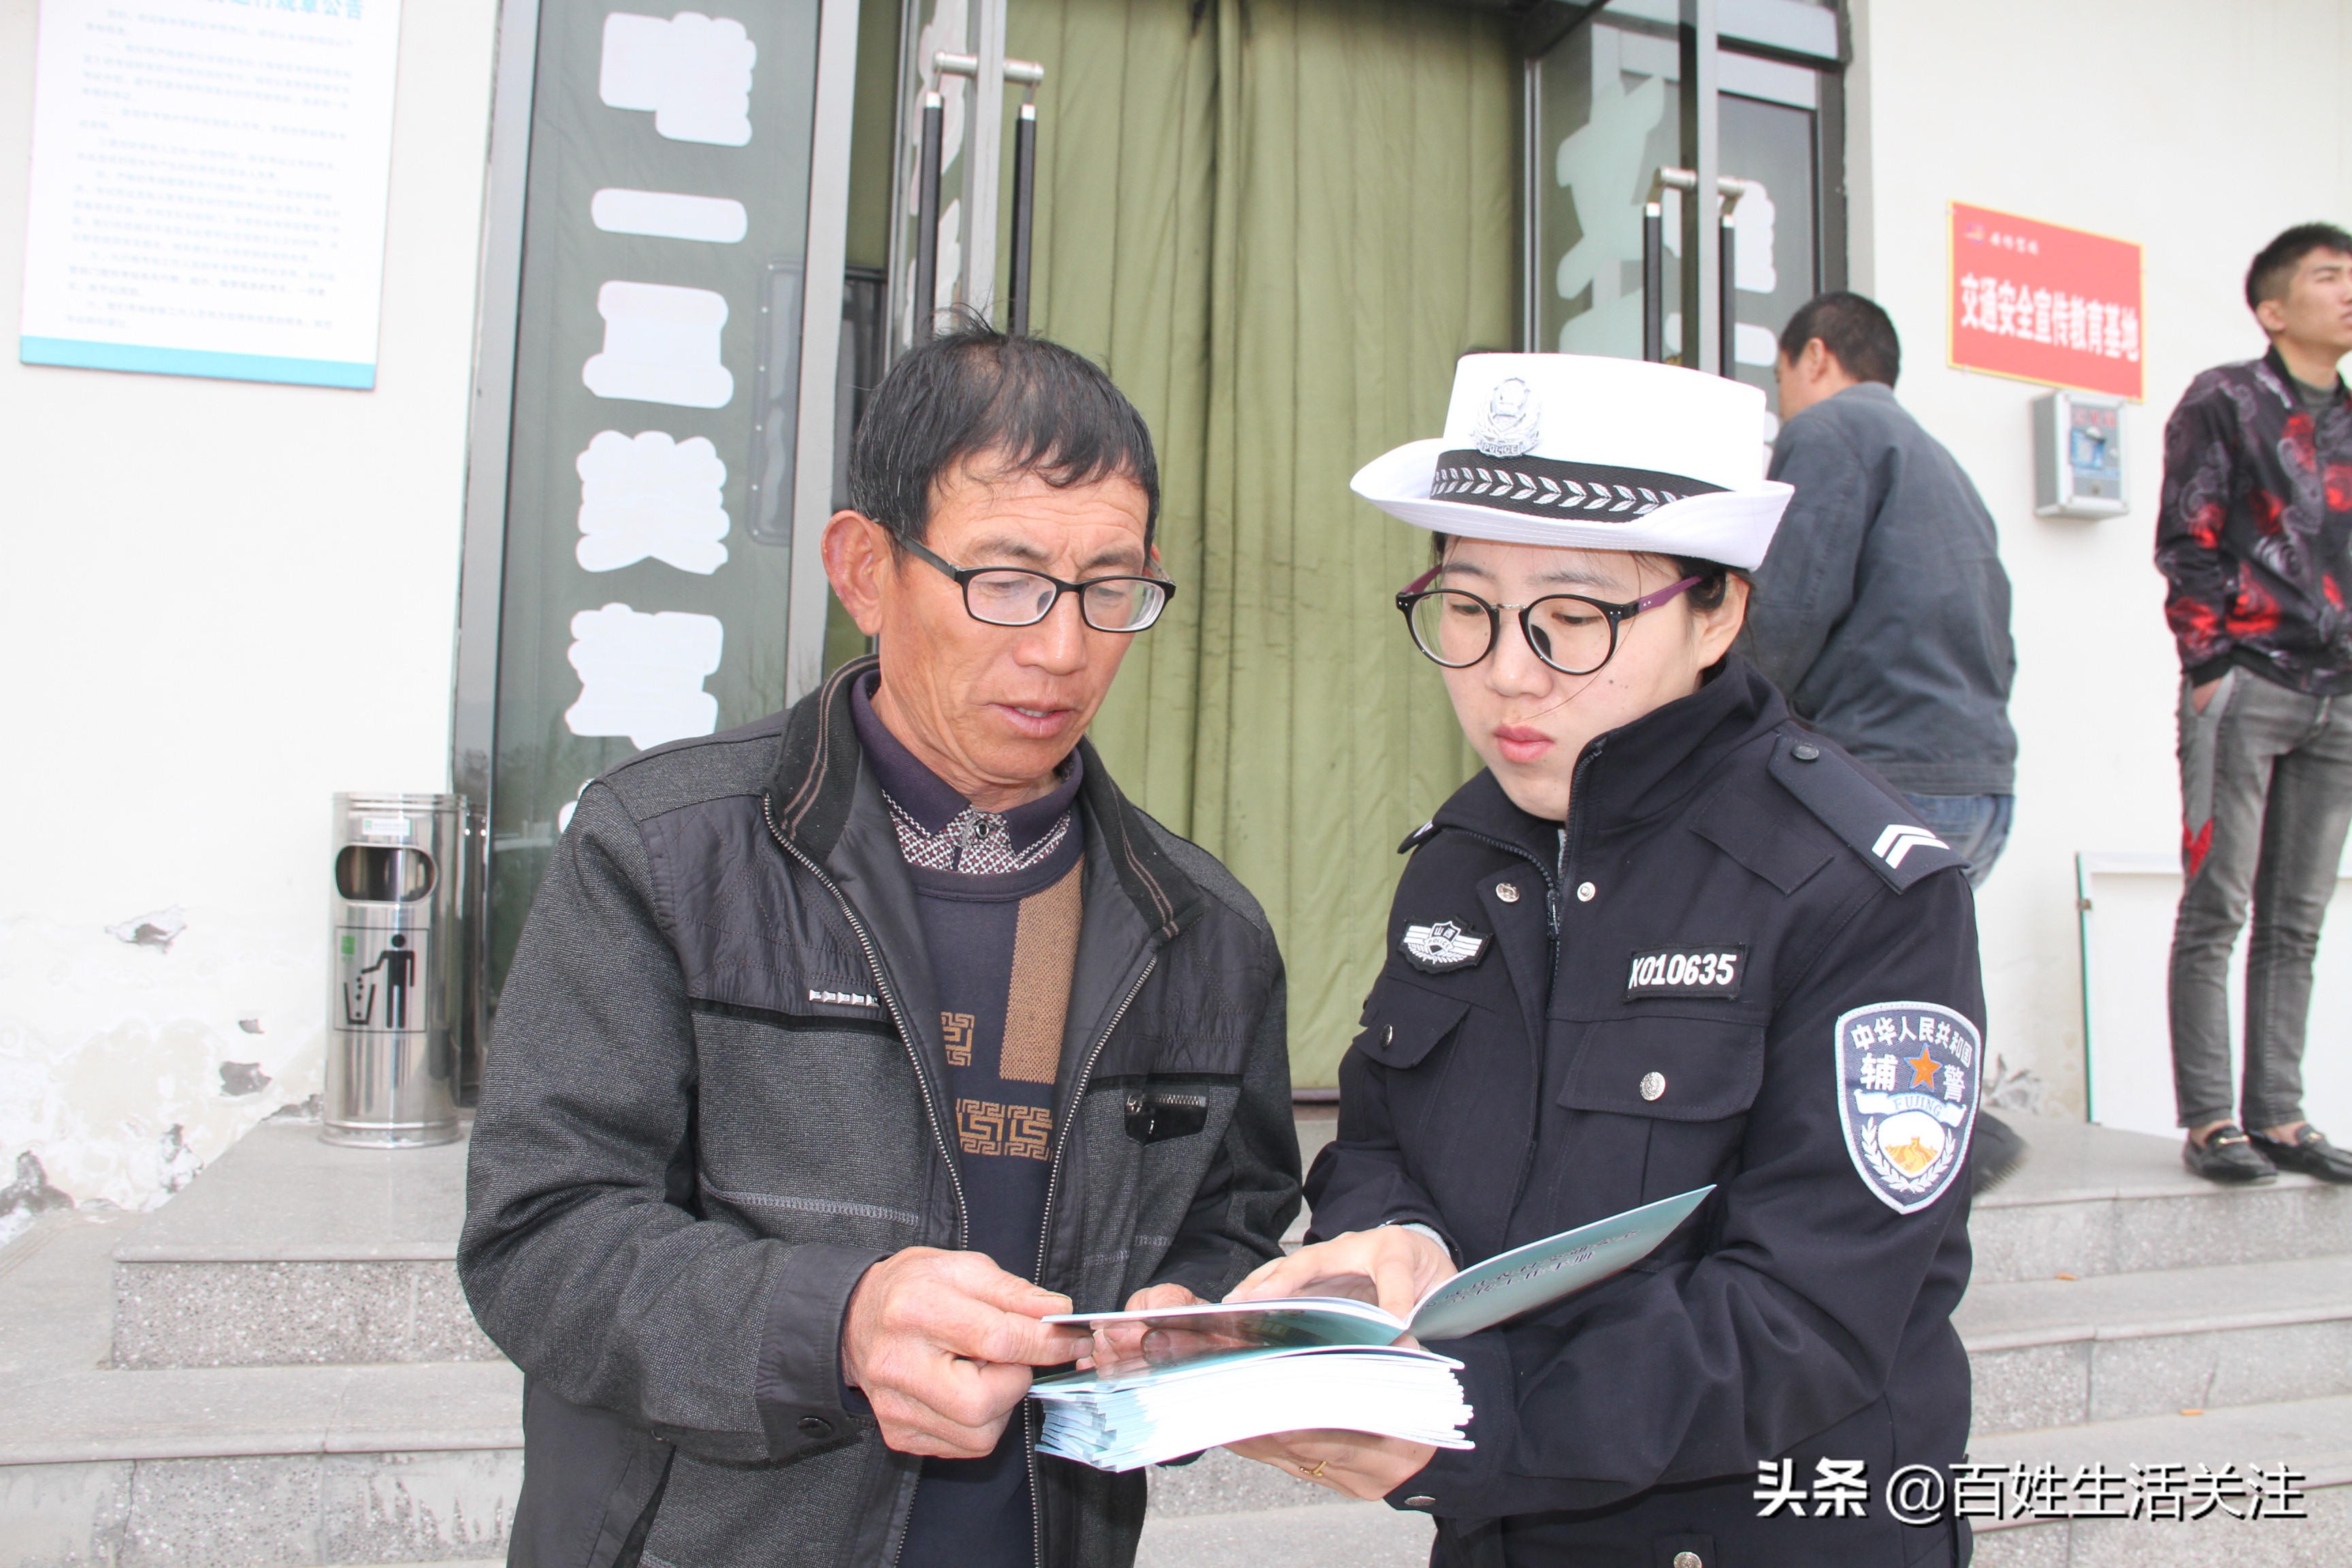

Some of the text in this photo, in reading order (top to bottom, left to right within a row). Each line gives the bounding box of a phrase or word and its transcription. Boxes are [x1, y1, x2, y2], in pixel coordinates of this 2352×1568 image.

[1961, 272, 2140, 362] 交通安全宣传教育基地
[1482, 443, 1520, 454] POLICE
[1427, 938, 1452, 950] POLICE
[1850, 1015, 1972, 1068] 中华人民共和国
[1893, 1094, 1942, 1117] FUJING
